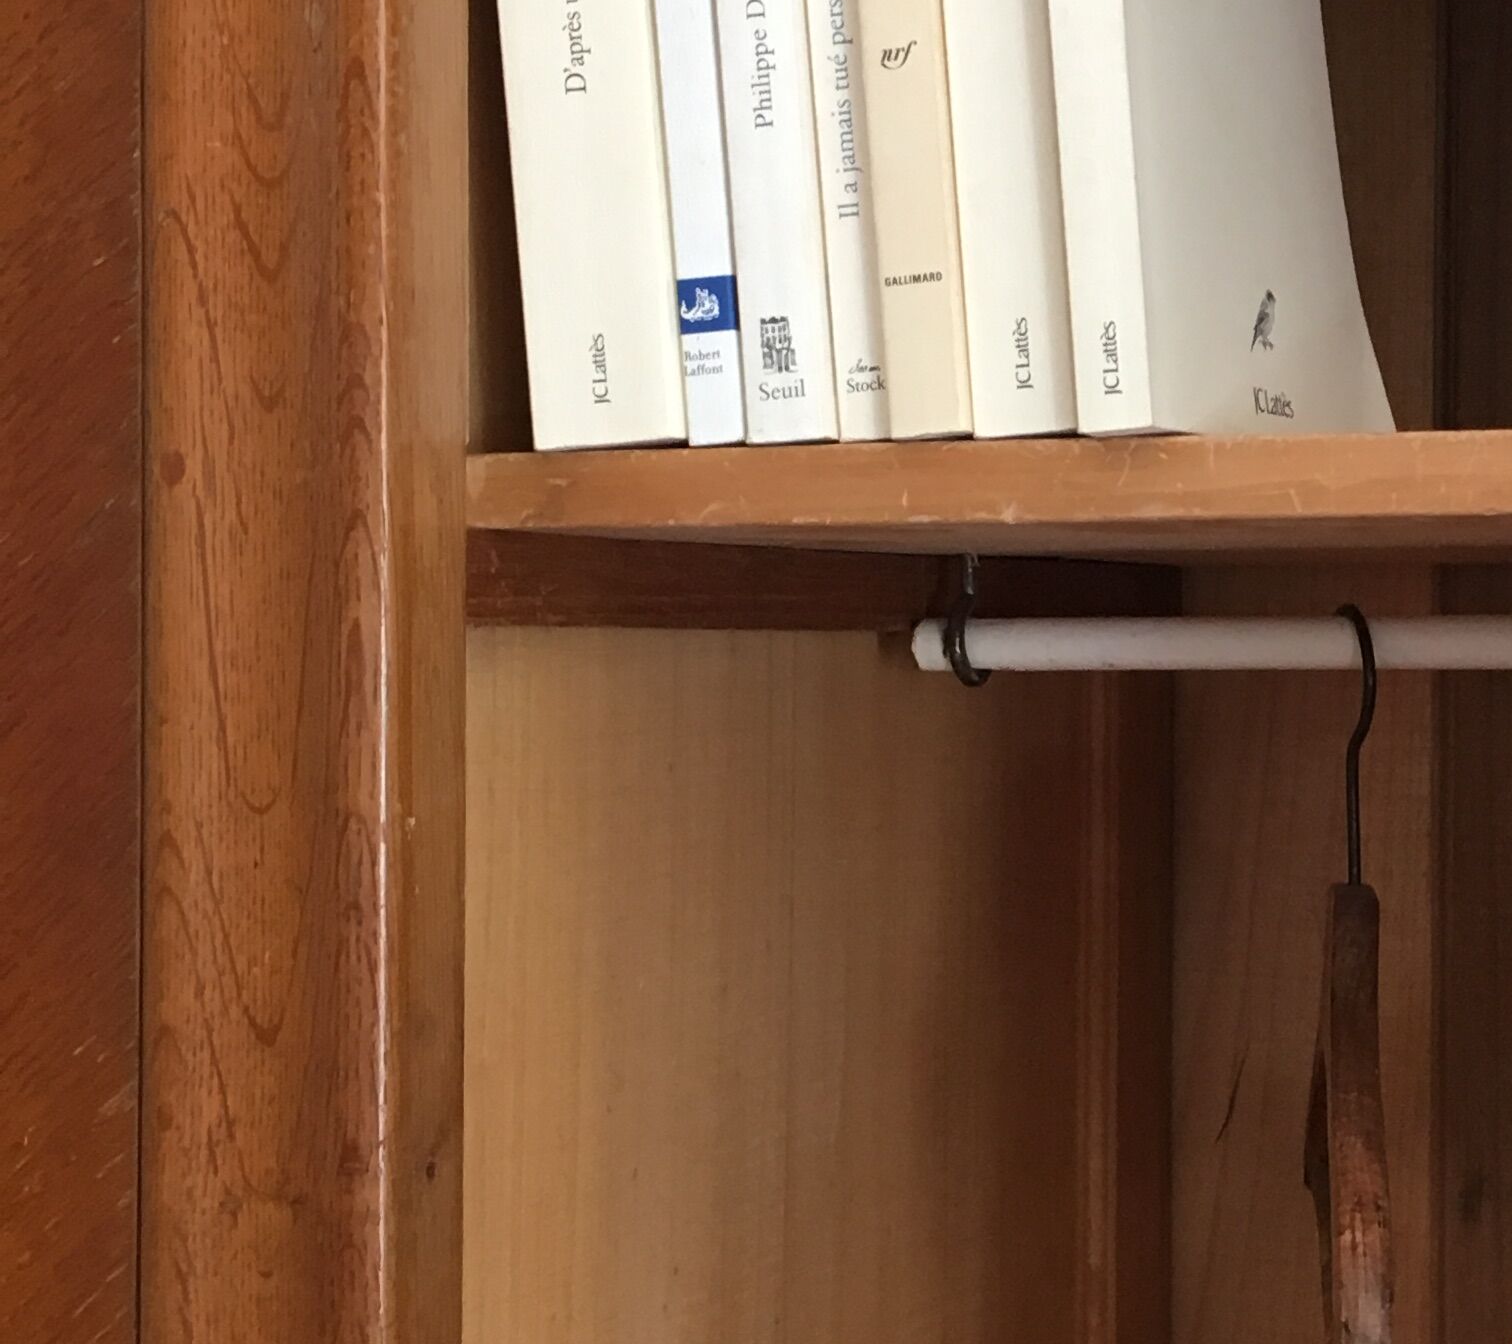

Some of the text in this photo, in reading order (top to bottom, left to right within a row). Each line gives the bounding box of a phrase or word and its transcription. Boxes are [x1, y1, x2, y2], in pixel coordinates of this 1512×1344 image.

[563, 11, 591, 94] D'après
[751, 29, 776, 130] Philippe
[826, 53, 851, 91] tué
[831, 98, 864, 174] jamais
[842, 182, 858, 194] a
[836, 200, 860, 219] Il
[884, 271, 943, 288] GALLIMARD
[683, 348, 721, 363] Robert
[683, 362, 724, 377] Laffont
[758, 378, 807, 402] Seuil
[845, 374, 886, 395] Stock
